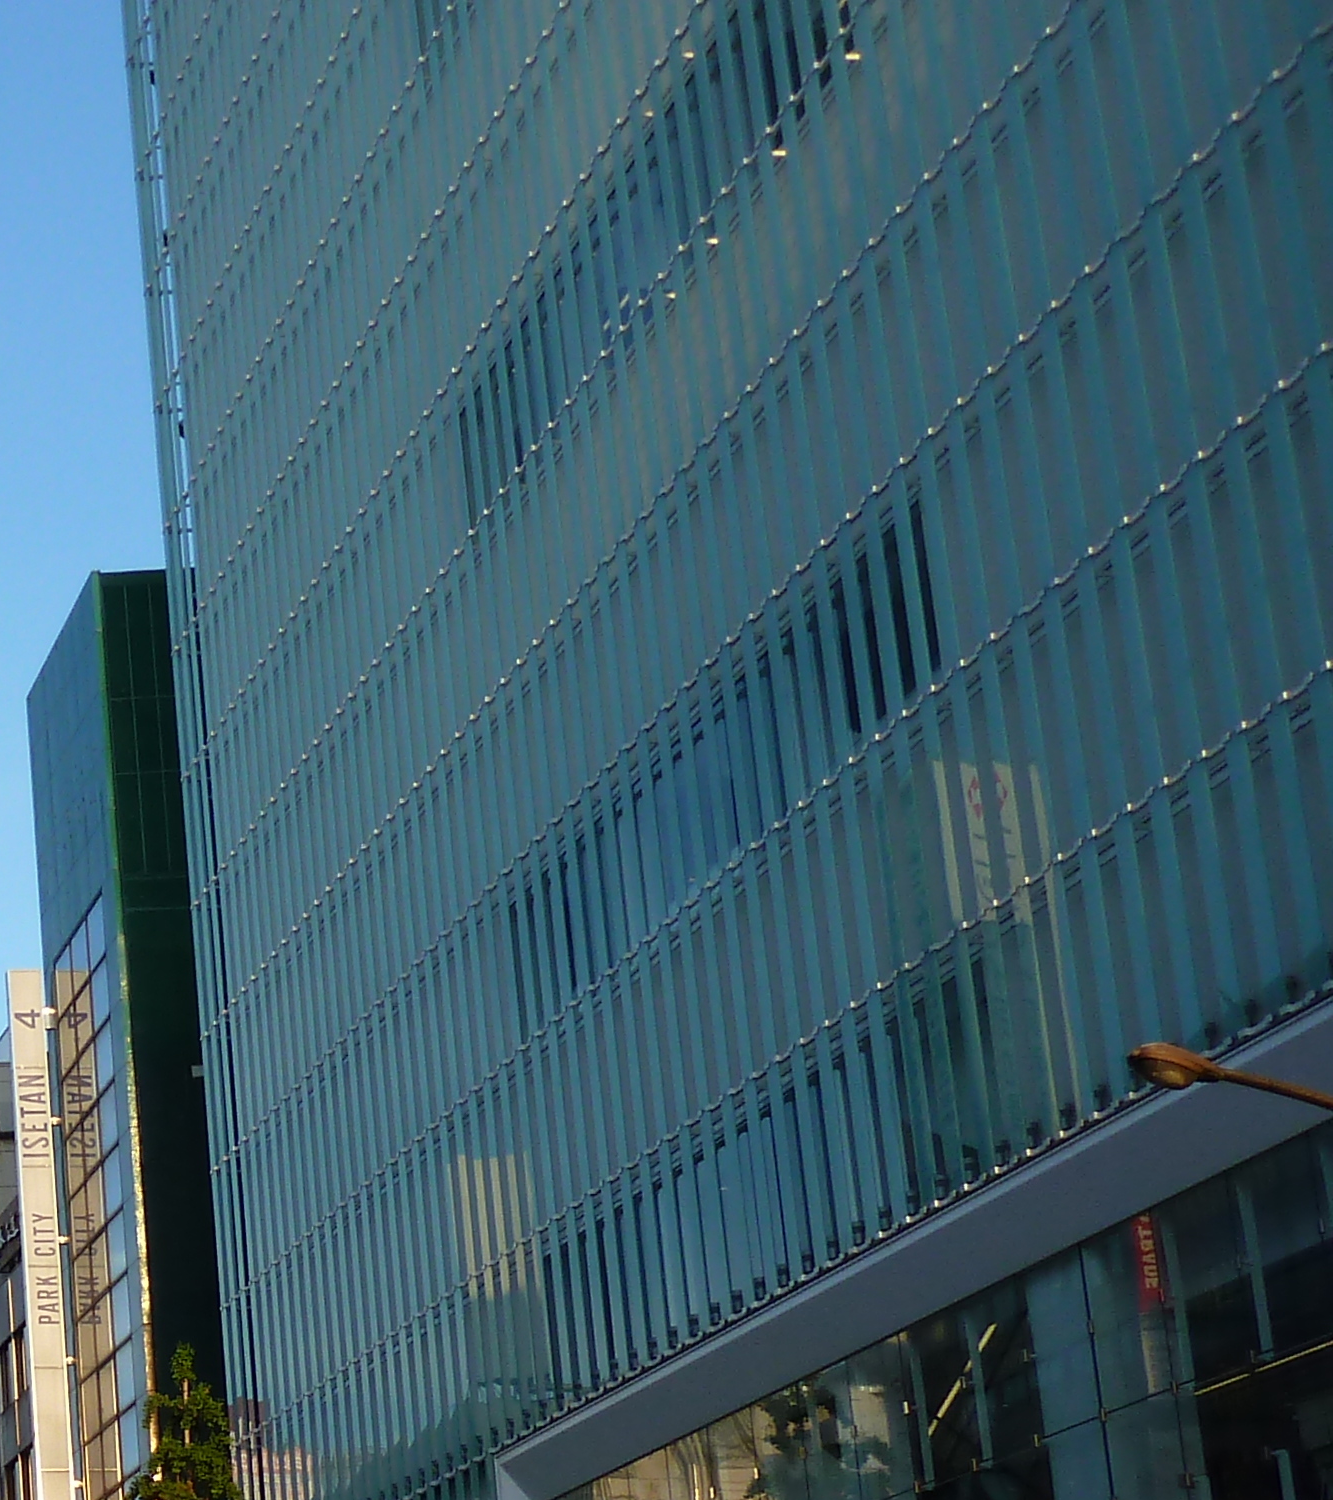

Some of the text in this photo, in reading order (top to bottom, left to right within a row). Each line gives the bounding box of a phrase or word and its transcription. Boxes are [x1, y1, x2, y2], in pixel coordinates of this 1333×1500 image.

[17, 1073, 50, 1160] ISETAN
[31, 1212, 55, 1258] CITY
[37, 1274, 61, 1325] PARK
